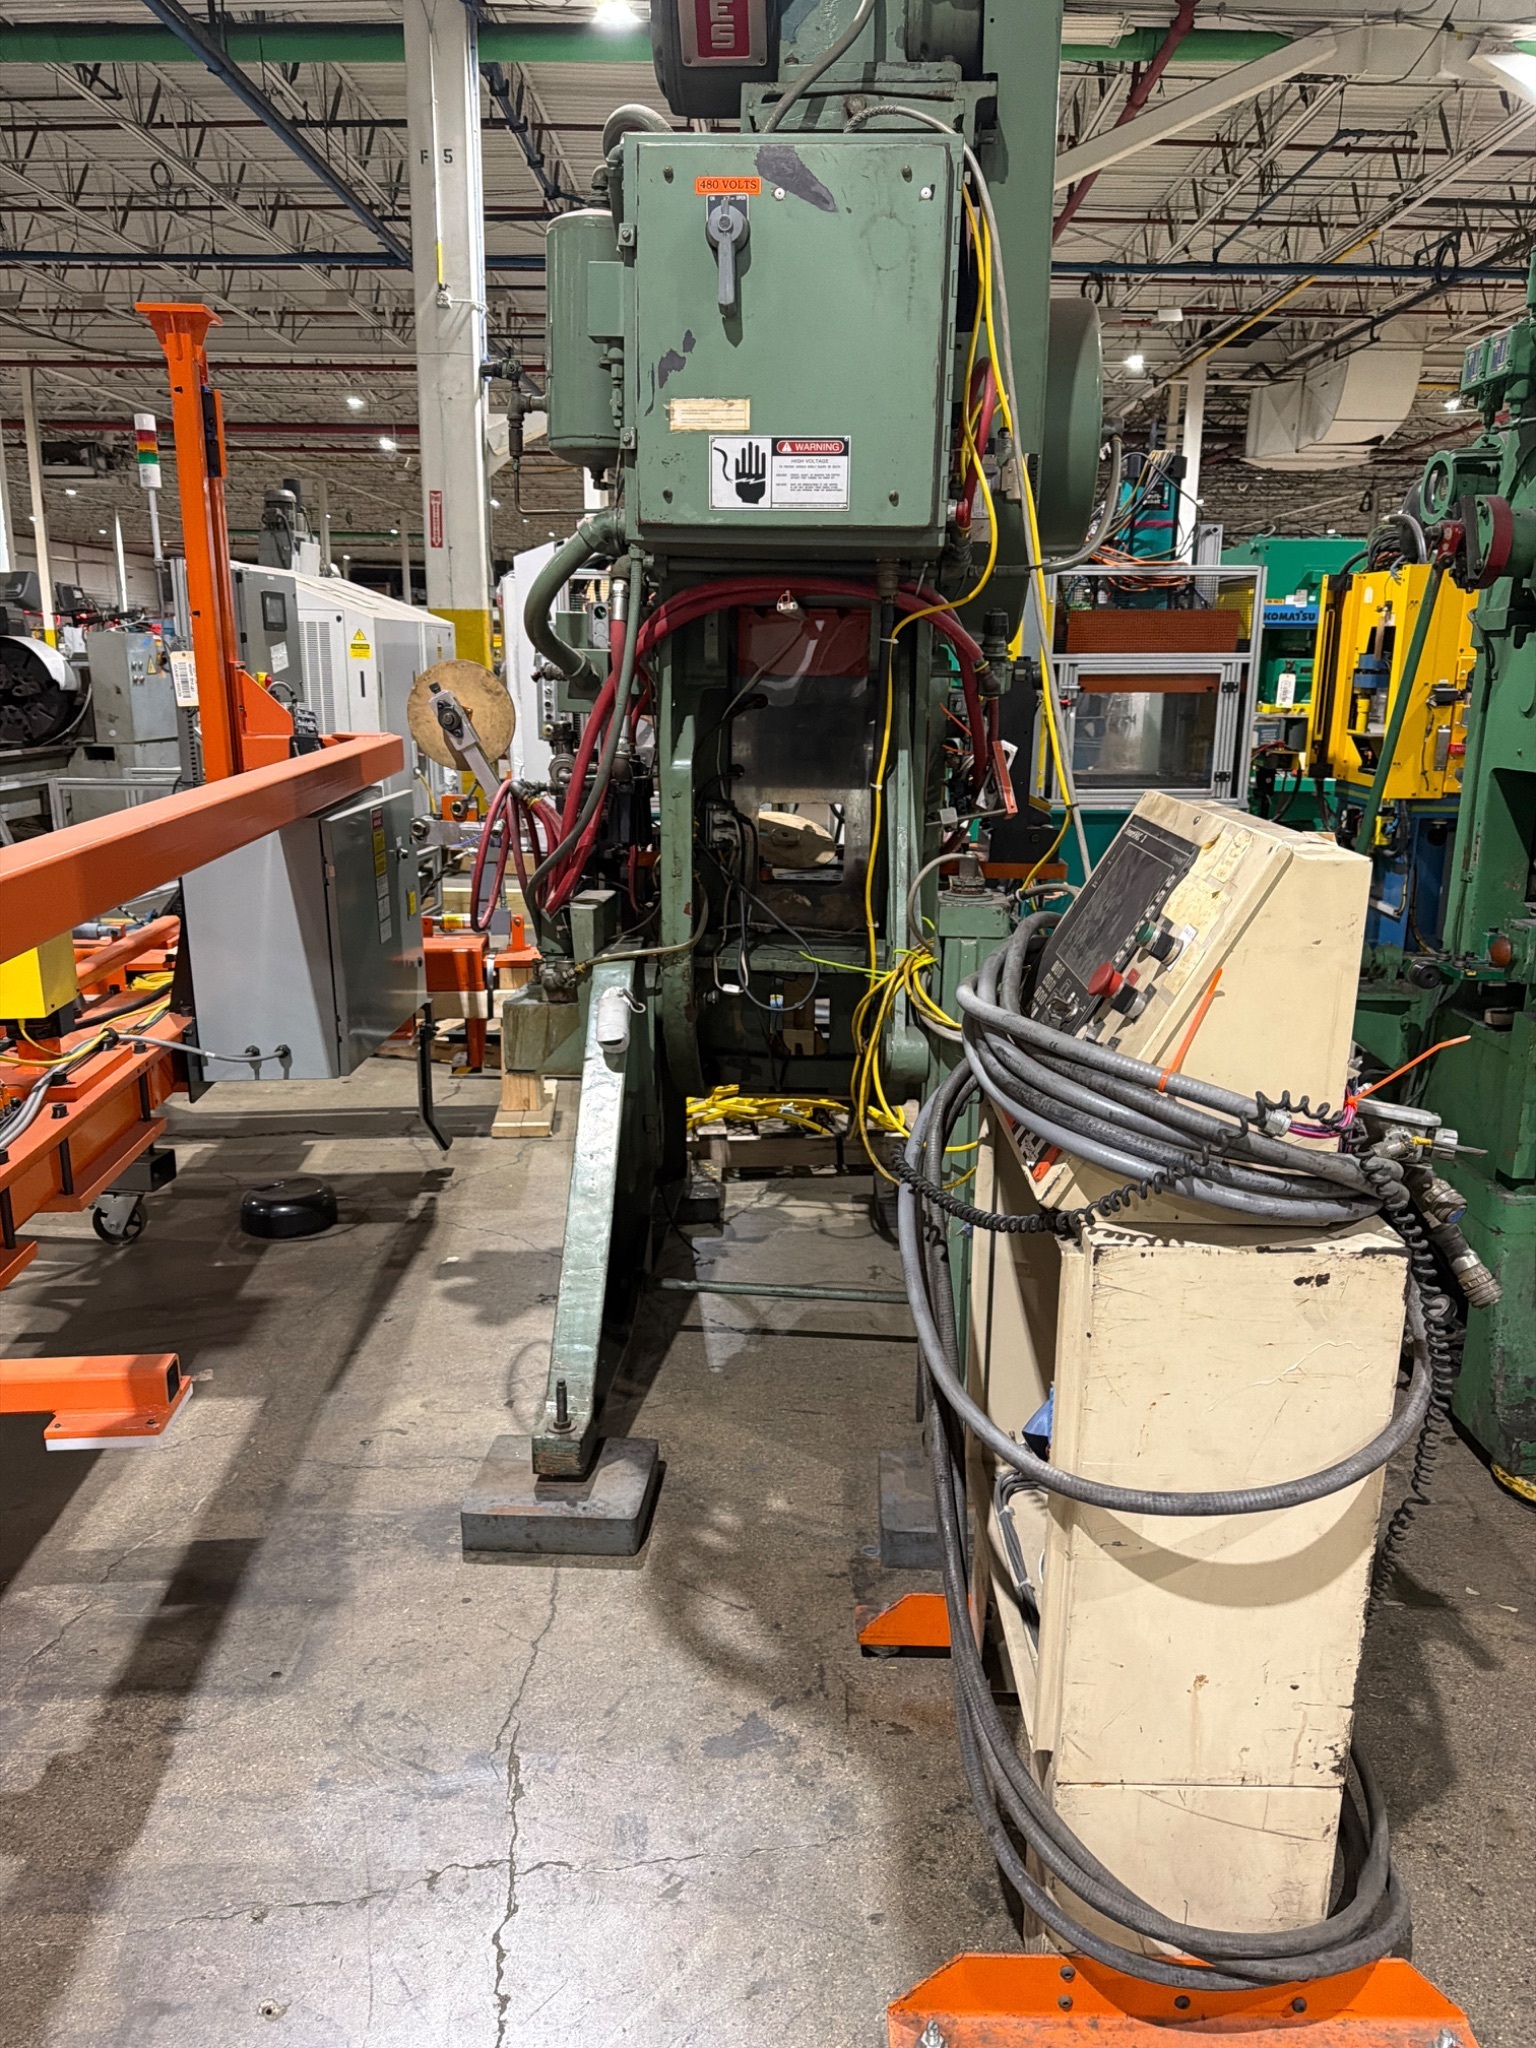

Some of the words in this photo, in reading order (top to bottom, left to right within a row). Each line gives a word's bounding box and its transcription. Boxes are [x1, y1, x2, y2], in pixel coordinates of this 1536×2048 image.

[420, 150, 428, 165] F
[443, 148, 453, 164] 5
[700, 179, 719, 189] 480
[722, 179, 757, 189] VOLTS
[795, 442, 840, 452] WARNING
[1264, 610, 1316, 621] KOMATSU
